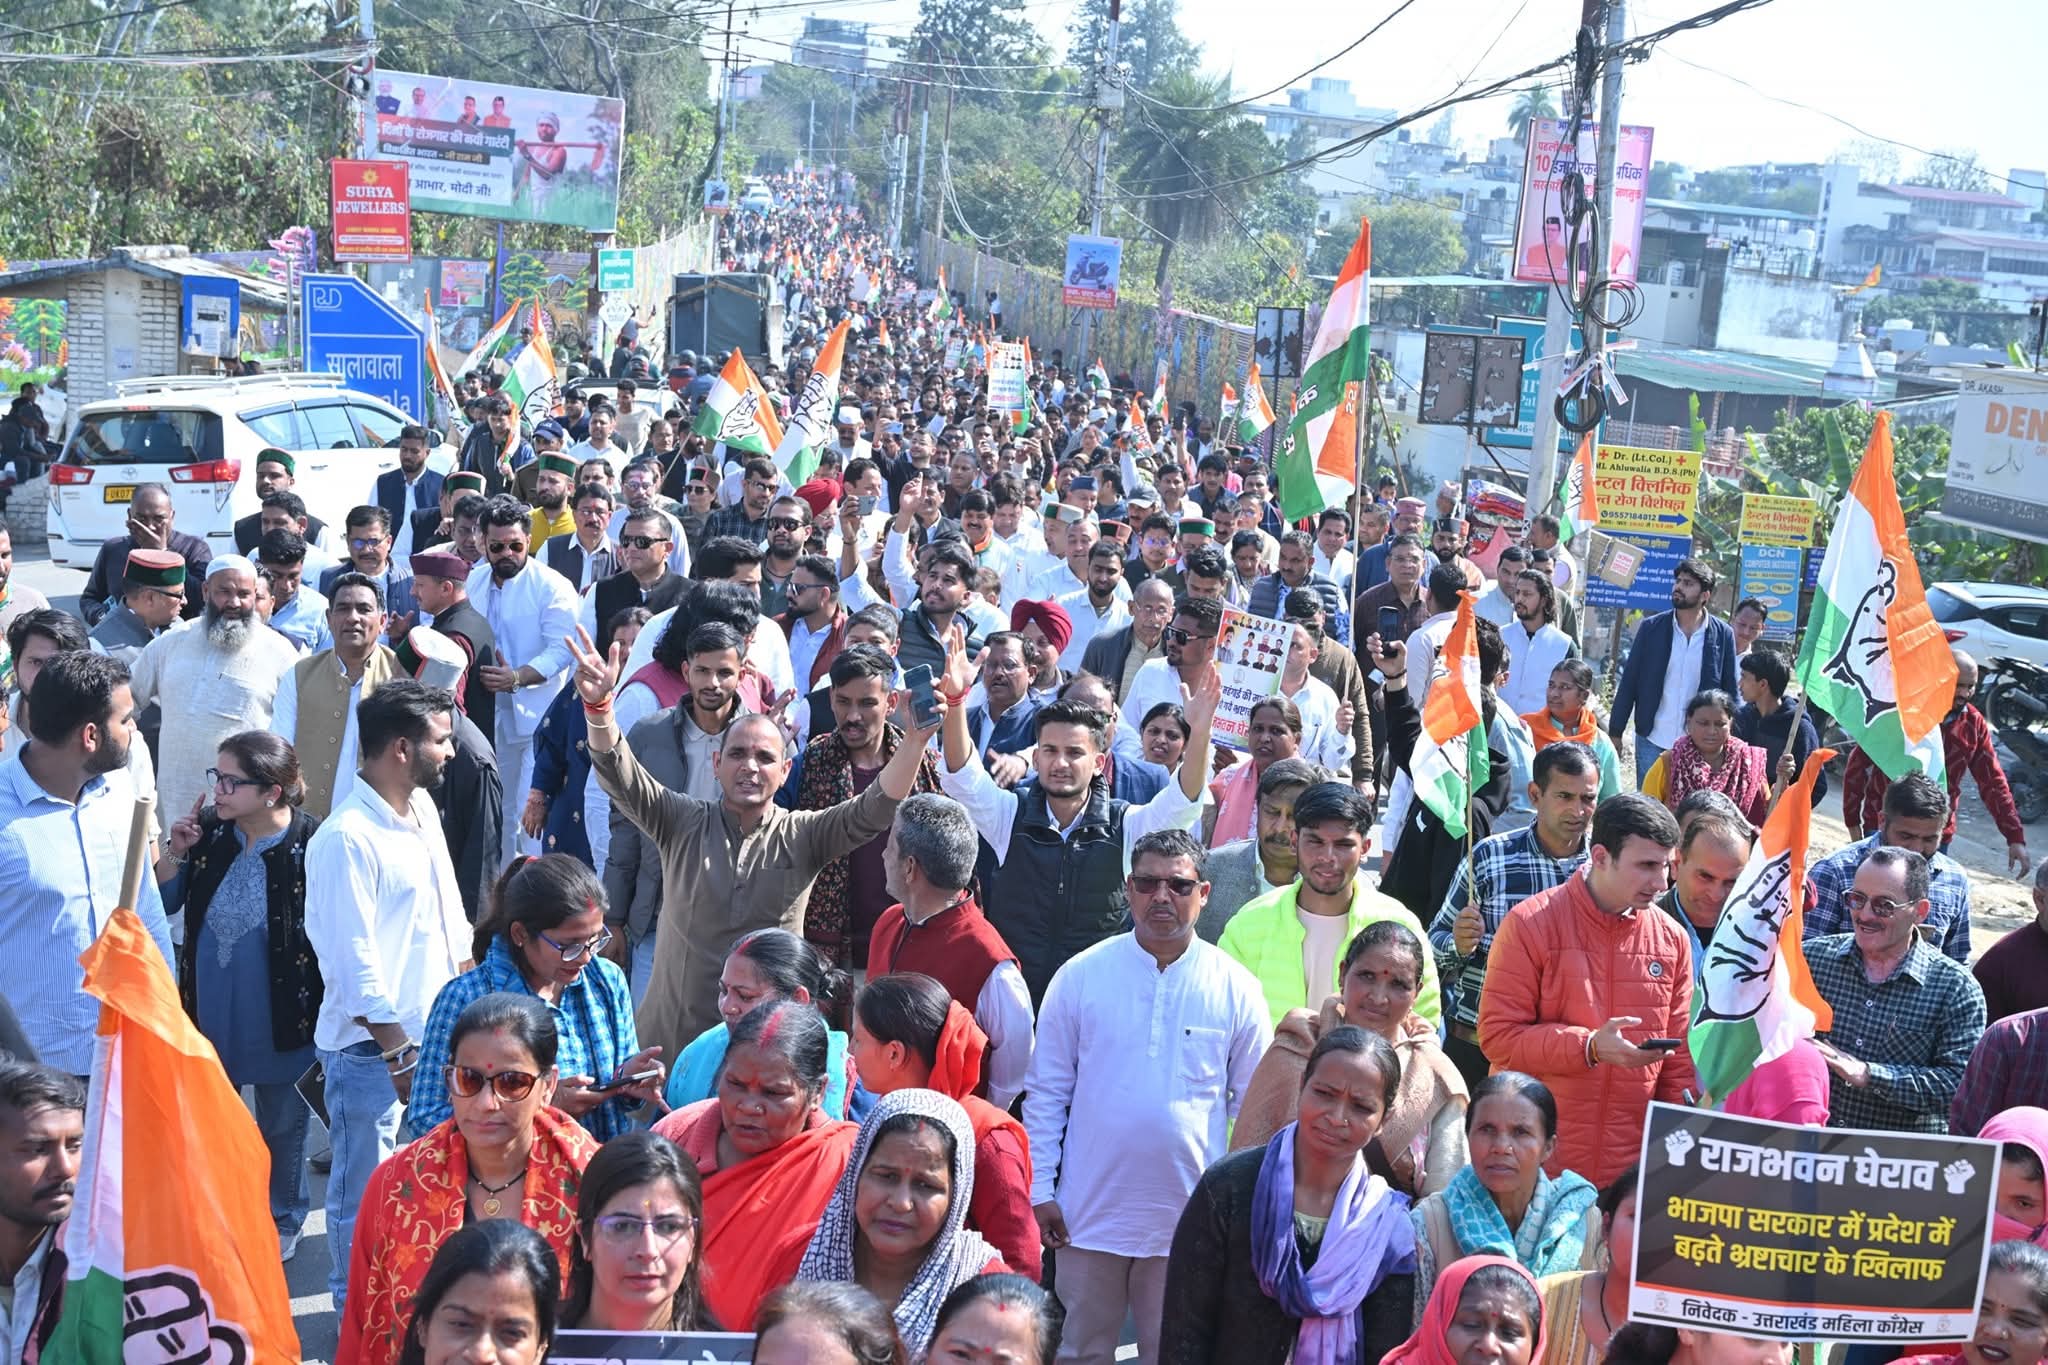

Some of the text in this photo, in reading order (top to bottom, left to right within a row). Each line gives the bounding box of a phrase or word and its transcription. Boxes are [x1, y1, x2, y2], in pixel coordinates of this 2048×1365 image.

[416, 127, 448, 142] रोजगार
[450, 129, 463, 144] की
[1536, 155, 1550, 172] 10
[346, 186, 394, 198] SURYA
[450, 180, 472, 194] मोदी
[336, 201, 405, 214] JEWELLERS
[1614, 452, 1672, 465] Dr. (Lt.Col.)
[1610, 464, 1651, 473] Ahluwalia
[1615, 493, 1636, 507] रोग
[1760, 549, 1784, 558] DCN
[1699, 1137, 1939, 1190] राजभवन घेराव
[1667, 1196, 1956, 1246] भाजपा सरकार में प्रदेश में
[1674, 1234, 1946, 1281] बढ़ते भ्रष्टाचार के खिलाफ
[1682, 1299, 1738, 1323] निवेदक
[1753, 1312, 1818, 1331] उत्तराखंड
[1822, 1315, 1874, 1333] महिला
